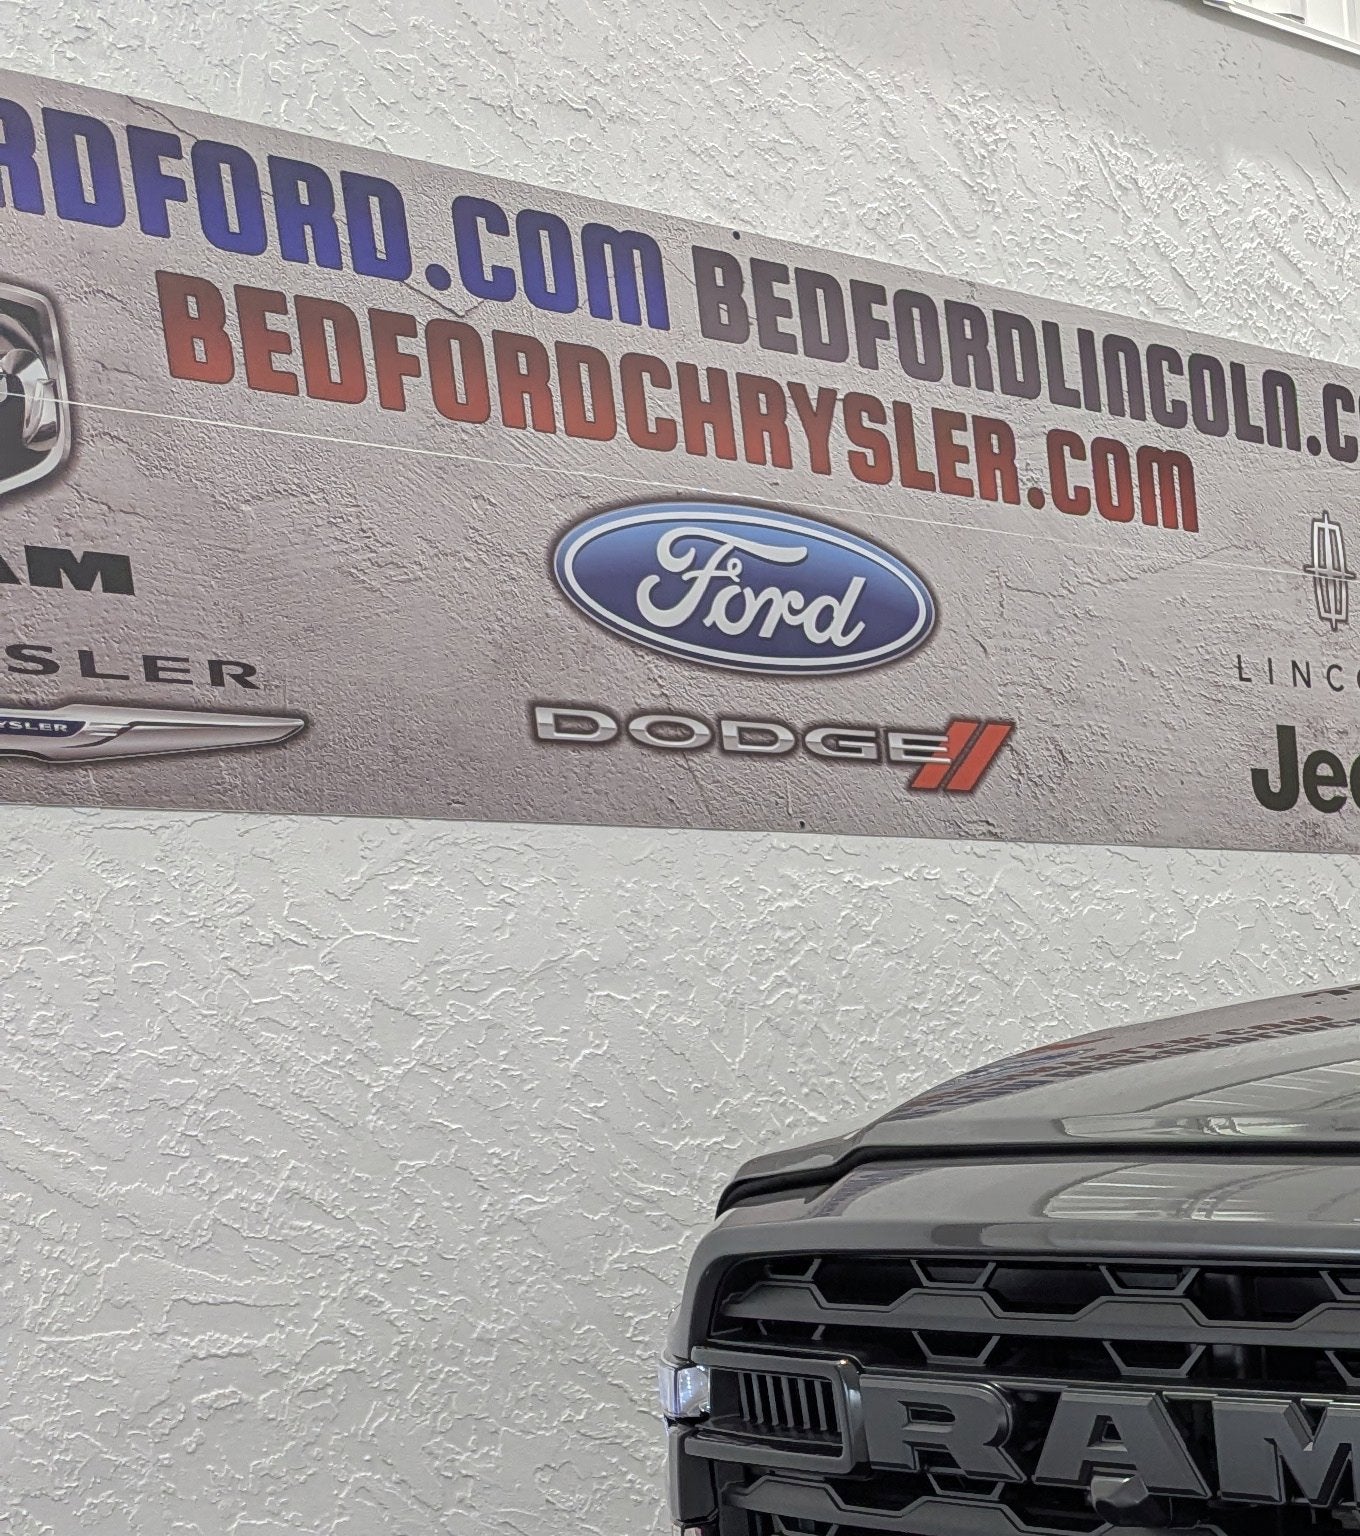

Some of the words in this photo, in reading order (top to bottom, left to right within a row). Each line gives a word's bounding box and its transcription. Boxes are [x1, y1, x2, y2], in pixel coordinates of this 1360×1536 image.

[156, 270, 1199, 533] BEDFORDCHRYSLER.COM
[636, 526, 867, 648] Ford
[534, 706, 952, 765] DODGE
